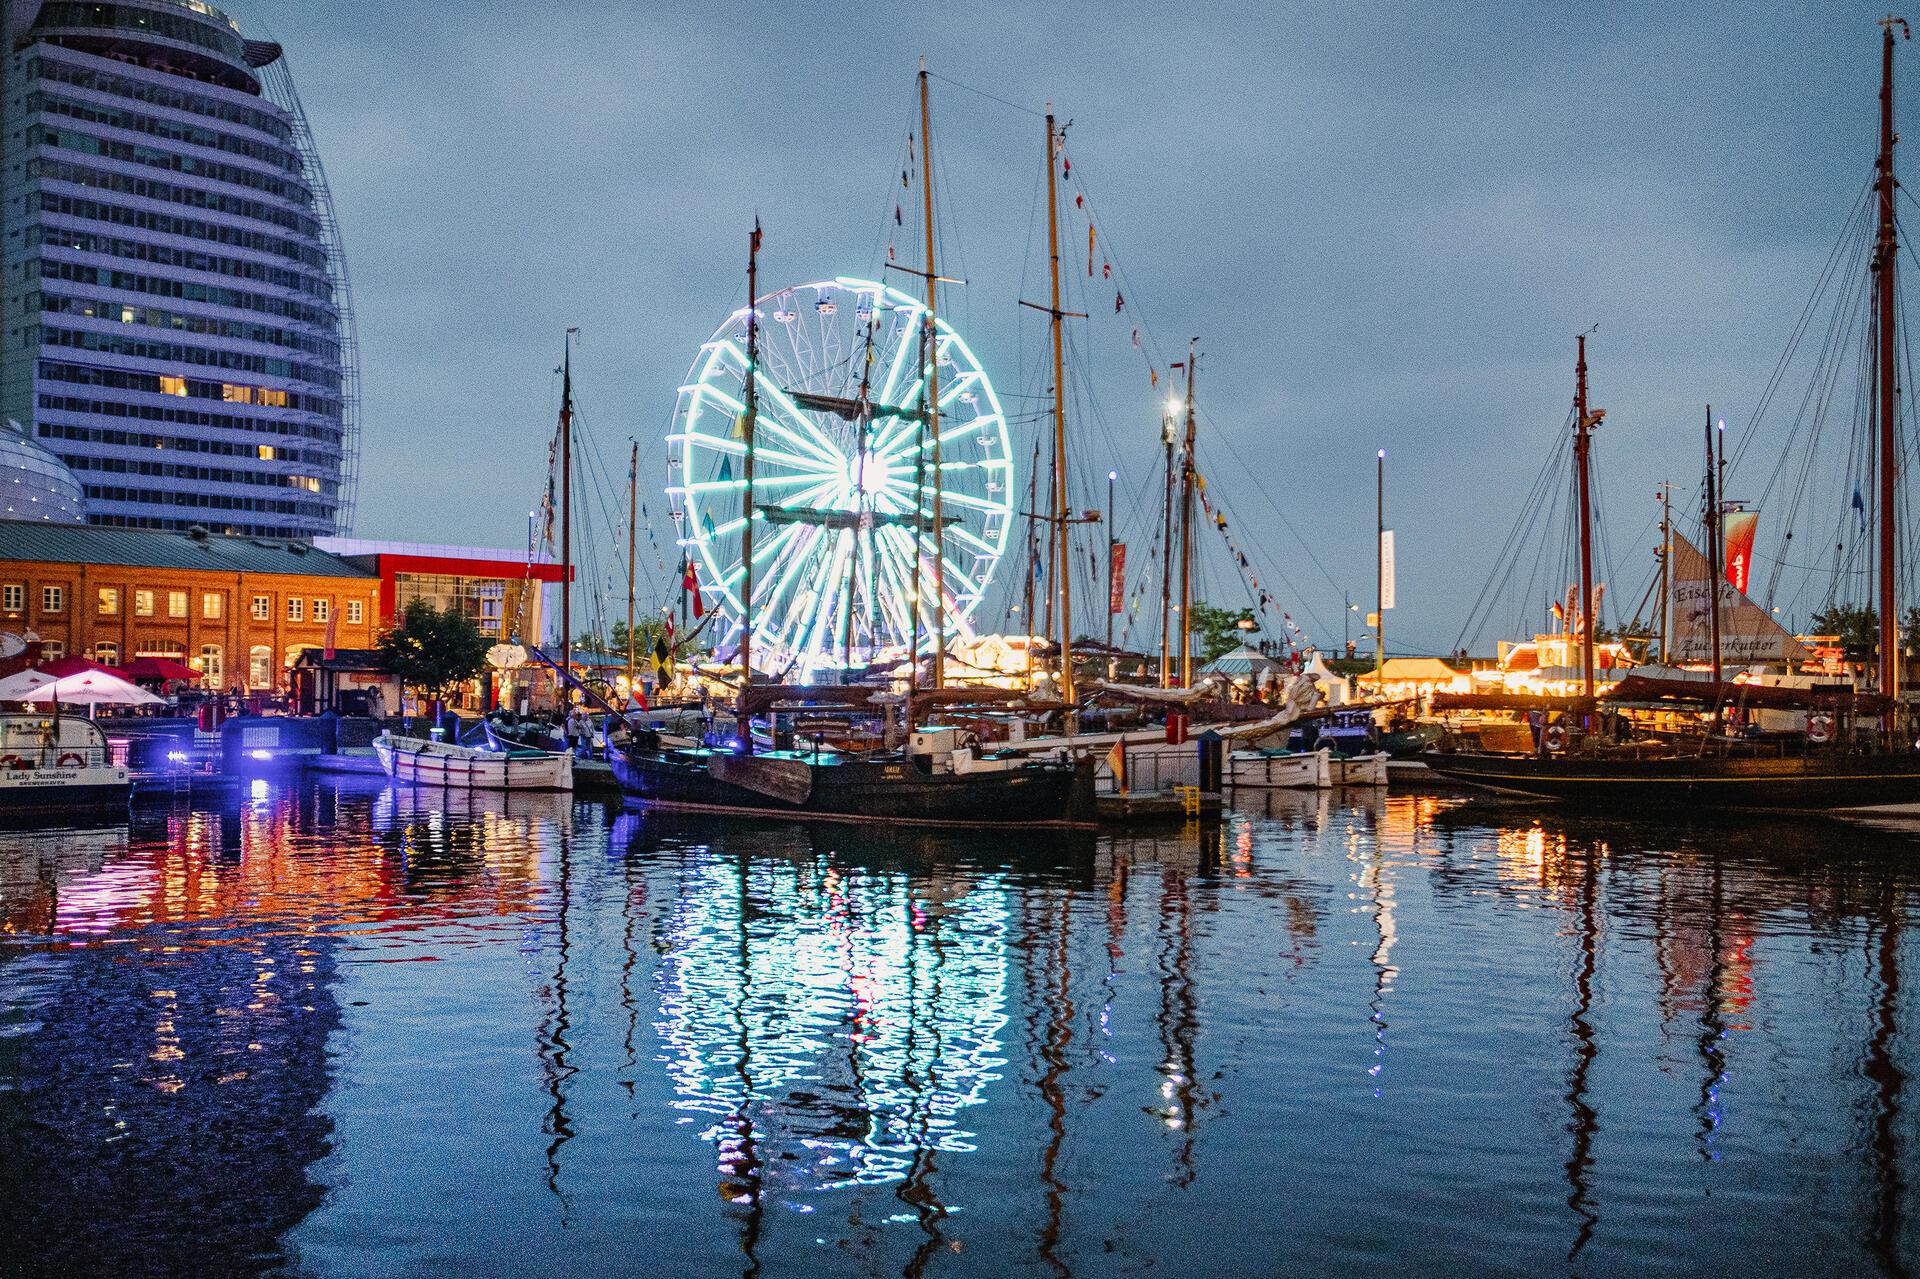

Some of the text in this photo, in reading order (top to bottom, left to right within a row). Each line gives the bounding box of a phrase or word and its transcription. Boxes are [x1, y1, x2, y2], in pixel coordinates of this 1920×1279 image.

[1732, 554, 1743, 589] swb
[1675, 583, 1736, 602] Eiscfé
[1681, 638, 1776, 653] Zucerkutter
[6, 771, 77, 781] Lady Sunshine
